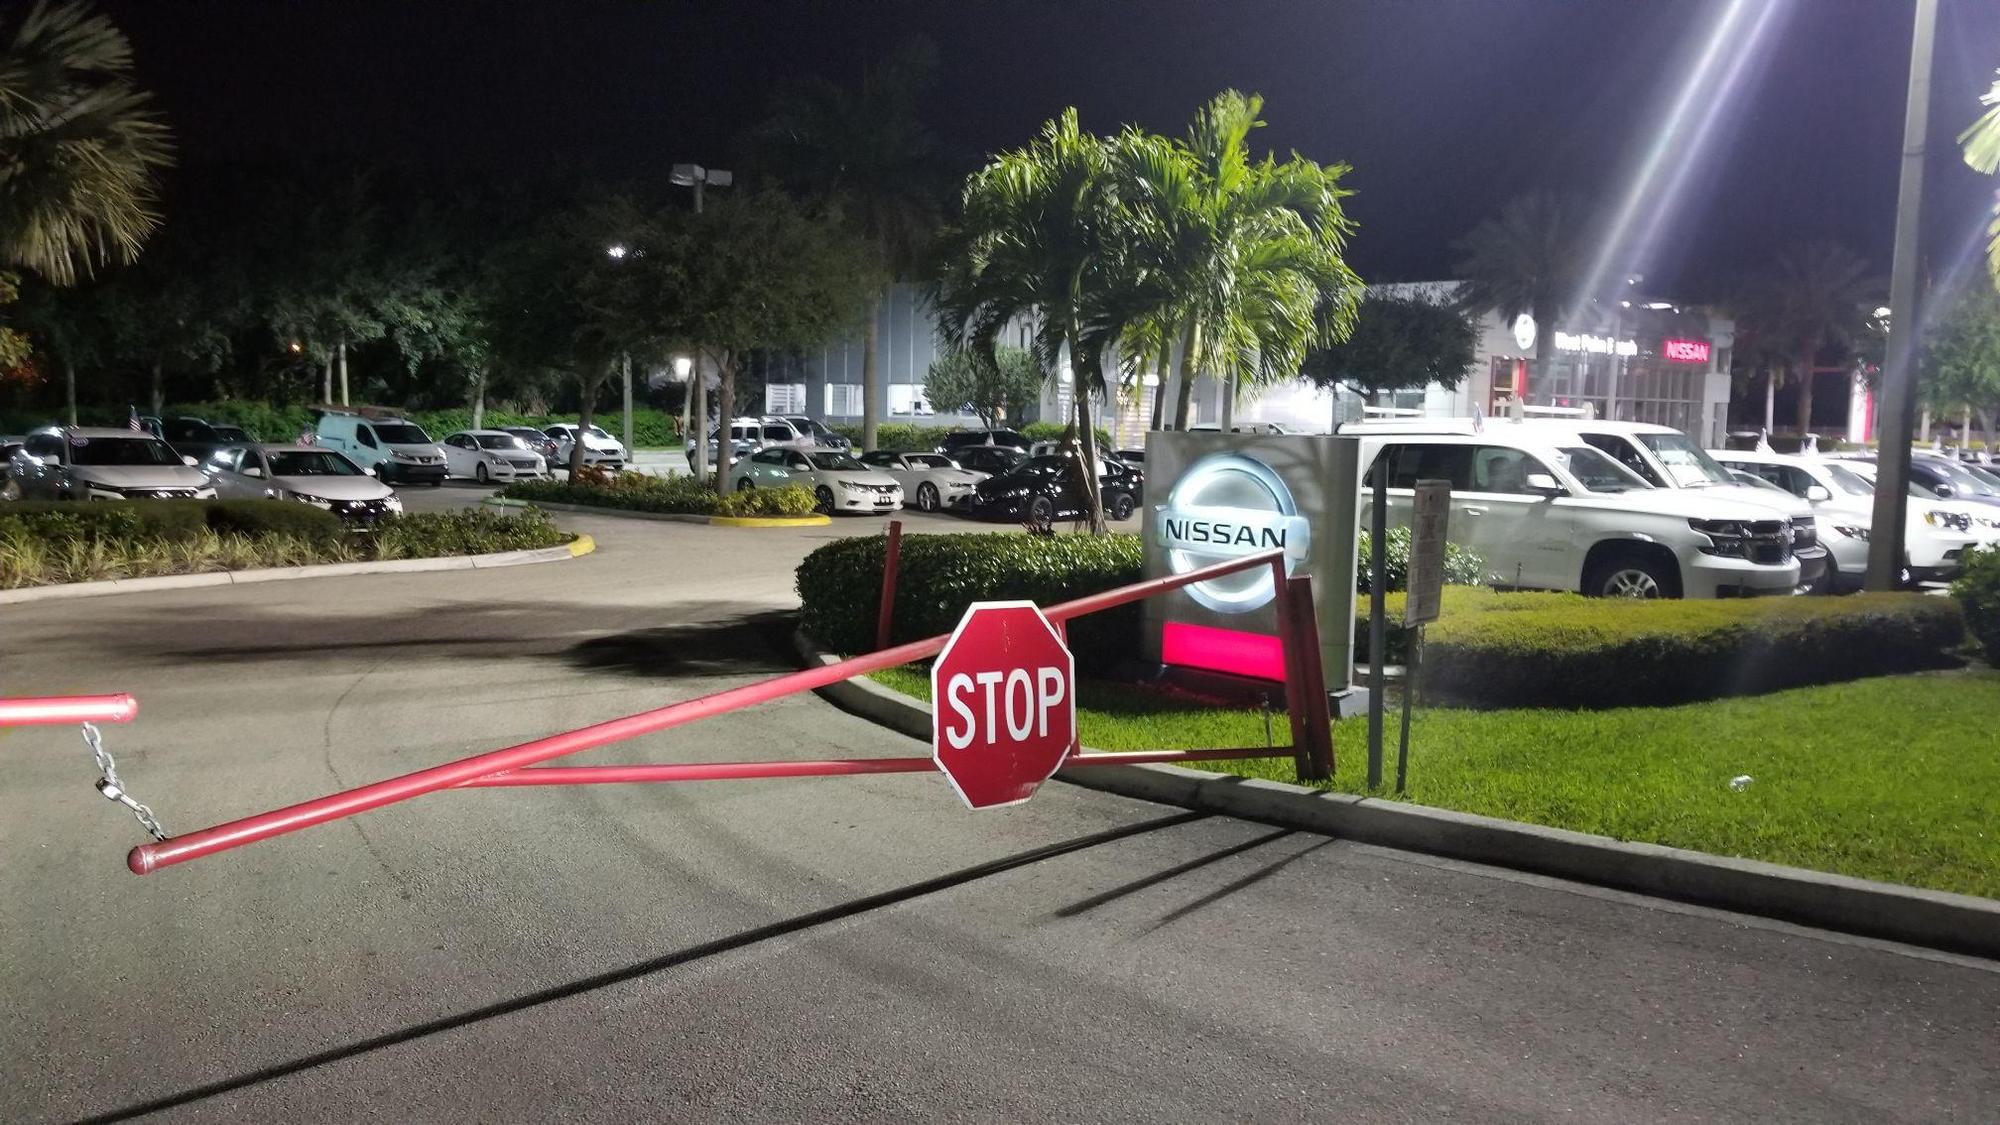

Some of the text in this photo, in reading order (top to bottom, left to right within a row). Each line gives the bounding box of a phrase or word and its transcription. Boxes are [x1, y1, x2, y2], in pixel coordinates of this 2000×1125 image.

[1666, 340, 1709, 361] NISSAN
[1165, 518, 1287, 549] NISSAN
[945, 666, 1065, 750] STOP
